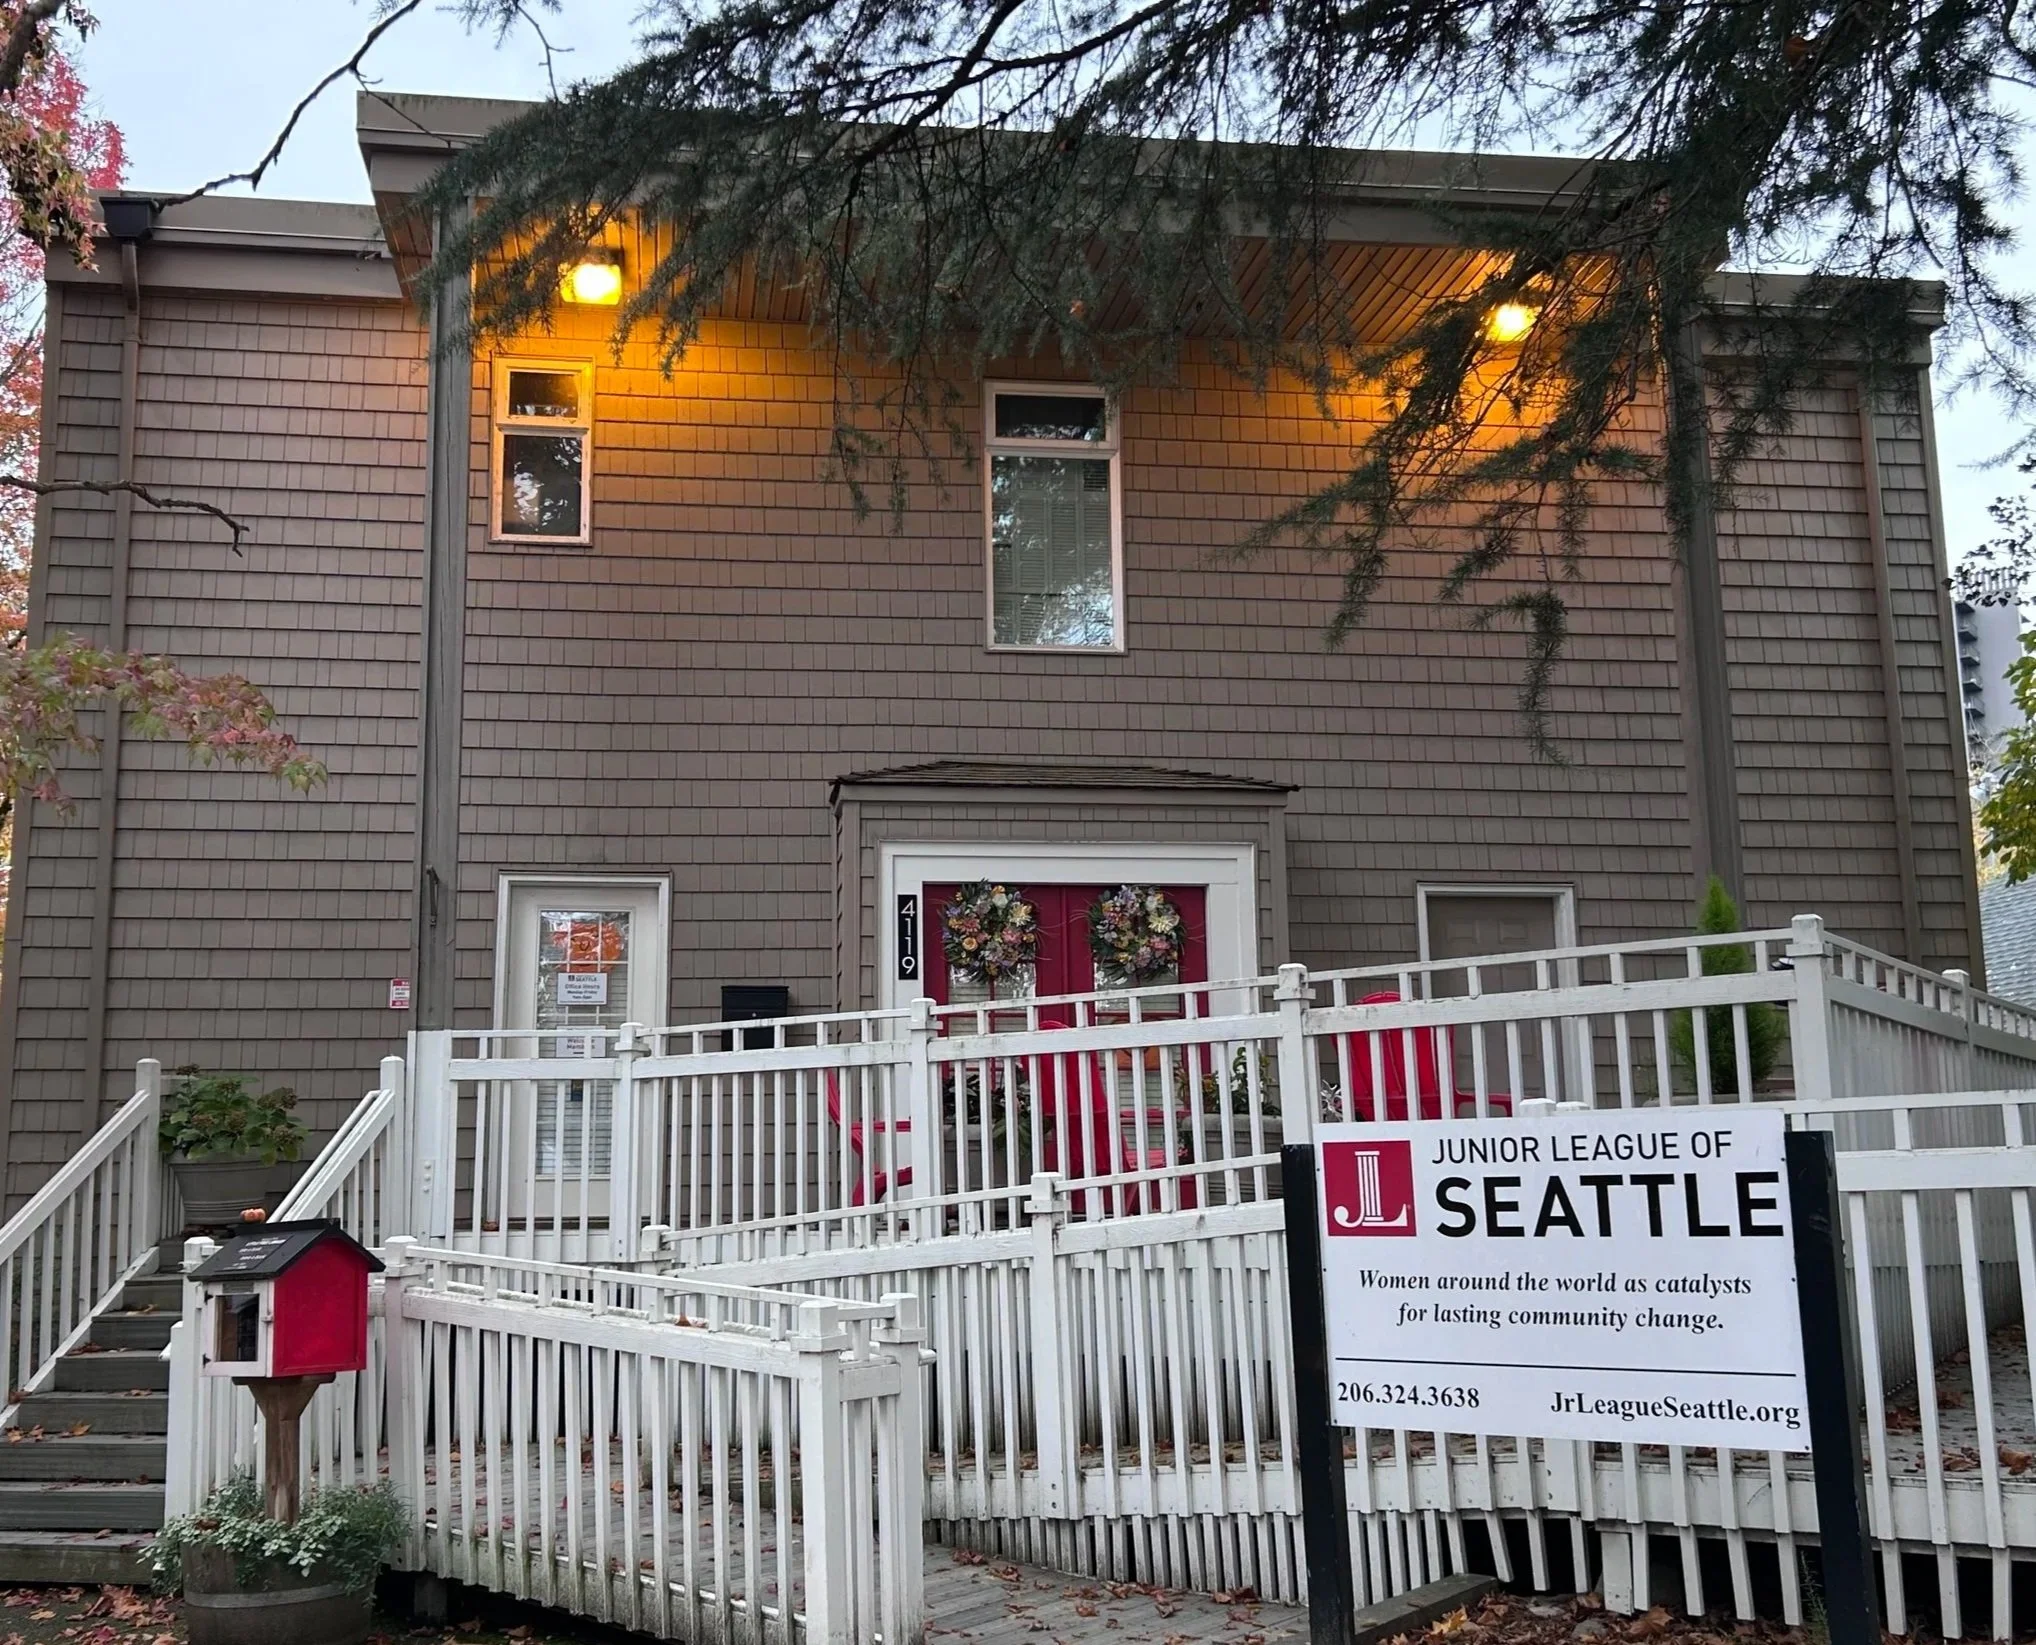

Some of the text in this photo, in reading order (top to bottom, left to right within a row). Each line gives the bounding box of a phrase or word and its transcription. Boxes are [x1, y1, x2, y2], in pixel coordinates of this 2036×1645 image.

[900, 899, 916, 975] 4119
[1431, 1130, 1733, 1164] JUNIOR LEAGUE OF
[1435, 1170, 1785, 1238] SEATTLE
[1359, 1269, 1752, 1299] Women around the world as catalysts
[1396, 1302, 1724, 1335] for lasting community change.
[1337, 1381, 1480, 1409] 206.324.3638
[1550, 1391, 1801, 1430] JrLeagueSeattle.org
